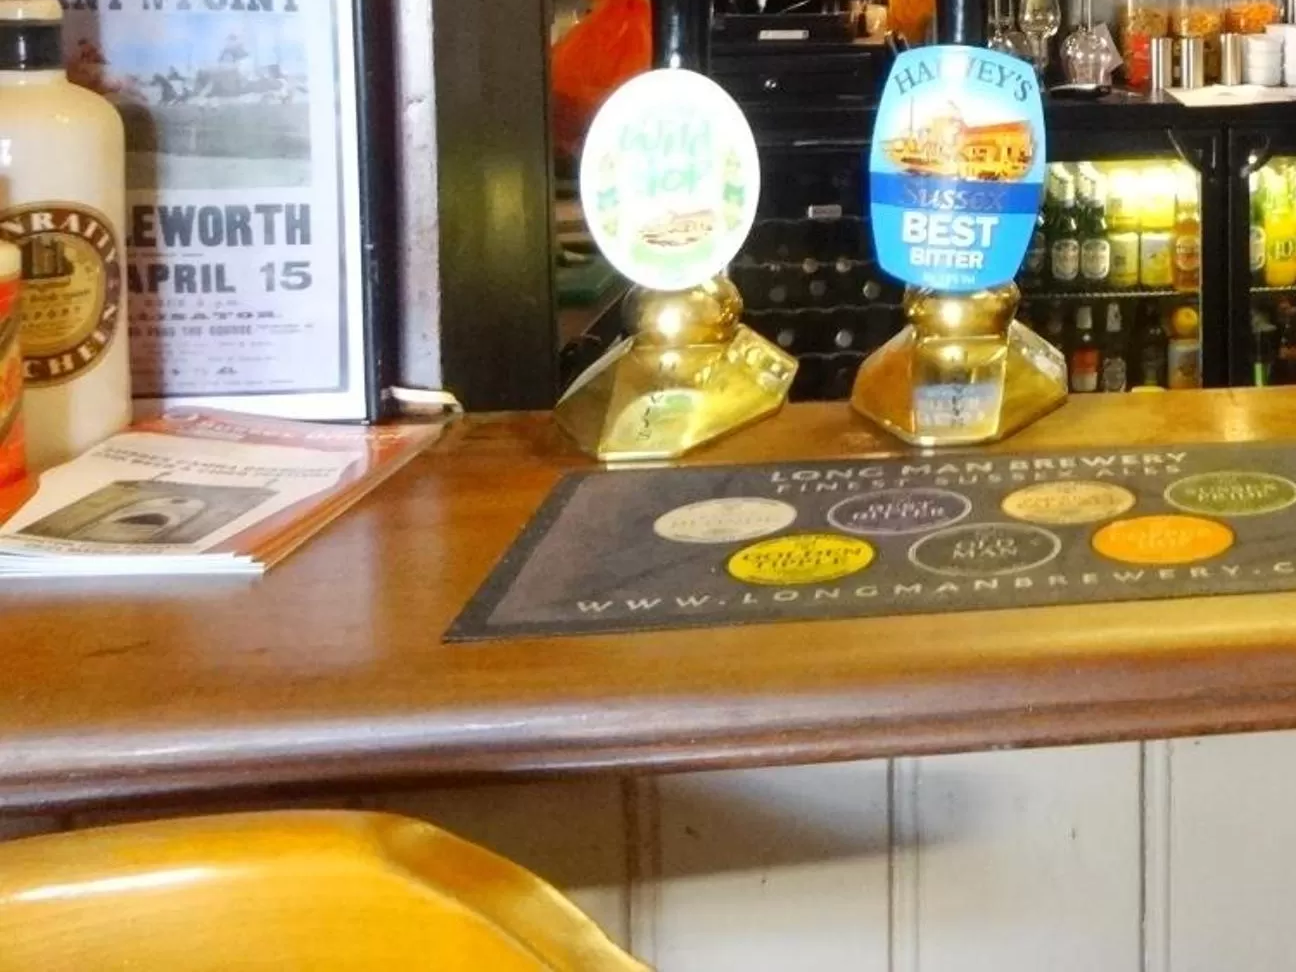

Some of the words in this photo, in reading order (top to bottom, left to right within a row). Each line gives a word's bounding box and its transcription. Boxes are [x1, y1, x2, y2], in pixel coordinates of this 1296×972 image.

[126, 203, 312, 248] EWORTH
[902, 211, 1000, 248] BEST
[909, 246, 984, 269] BITTER
[259, 260, 314, 293] 15
[770, 465, 885, 483] LONG
[901, 460, 993, 477] MAN
[1009, 451, 1188, 472] BREWERY
